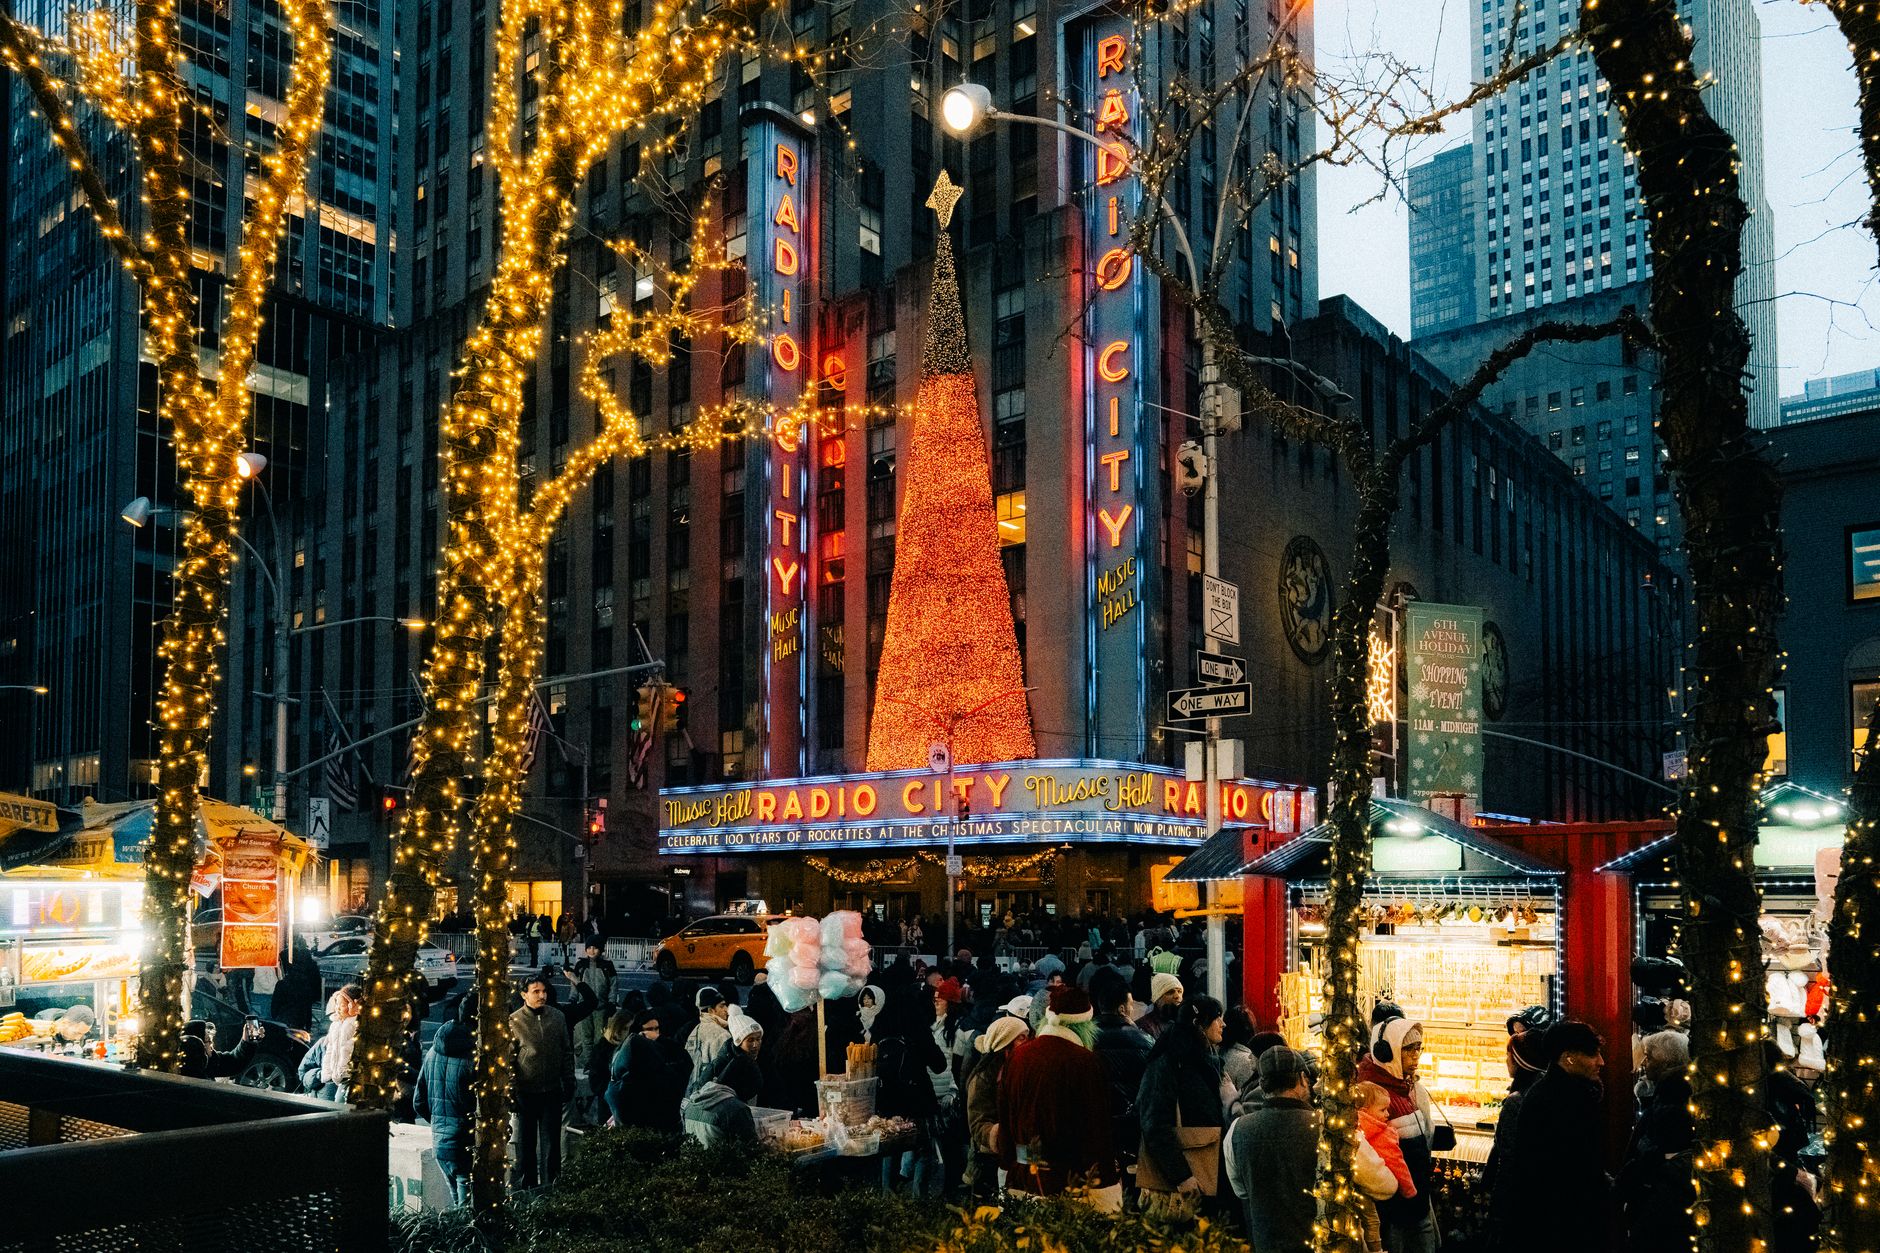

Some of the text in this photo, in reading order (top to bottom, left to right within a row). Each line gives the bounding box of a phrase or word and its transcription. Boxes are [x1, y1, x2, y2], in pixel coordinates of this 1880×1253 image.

[1097, 35, 1132, 547] RADIO CITY
[773, 144, 800, 595] RADIO CITY
[1098, 557, 1135, 603] MUSIC
[1206, 580, 1236, 600] DON'T BLOCK
[1103, 590, 1135, 630] HALL
[1211, 595, 1231, 611] THE BOX
[771, 608, 798, 638] MUSIC
[1434, 620, 1457, 630] 6TH
[1419, 640, 1472, 654] HOLIDAY
[1423, 631, 1468, 643] AVENUE
[774, 636, 798, 664] HALL
[1204, 662, 1239, 679] ONE WAY
[1421, 663, 1468, 689] SHOPPING
[1181, 694, 1239, 711] ONE WAY
[1429, 689, 1463, 710] EVENT!
[1413, 719, 1433, 731] 11AM
[1440, 720, 1479, 734] MIDNIGHT
[665, 798, 713, 827] Music
[708, 789, 753, 828] Hall
[758, 784, 877, 822] RADIO
[903, 774, 1011, 814] CITY
[1025, 775, 1110, 809] Music
[1104, 772, 1154, 811] Hall
[1164, 780, 1248, 818] RAIO
[668, 834, 719, 847] CELEBRATE
[725, 833, 743, 845] 100
[749, 832, 781, 844] YEARS
[787, 831, 802, 842] OF
[808, 828, 872, 842] ROCKETTES
[879, 826, 894, 838] AT
[902, 826, 923, 838] THE
[931, 822, 1002, 837] CHISTMAS
[1133, 823, 1153, 836] NOW
[1157, 824, 1191, 840] PLAYING
[242, 883, 270, 891] Churros
